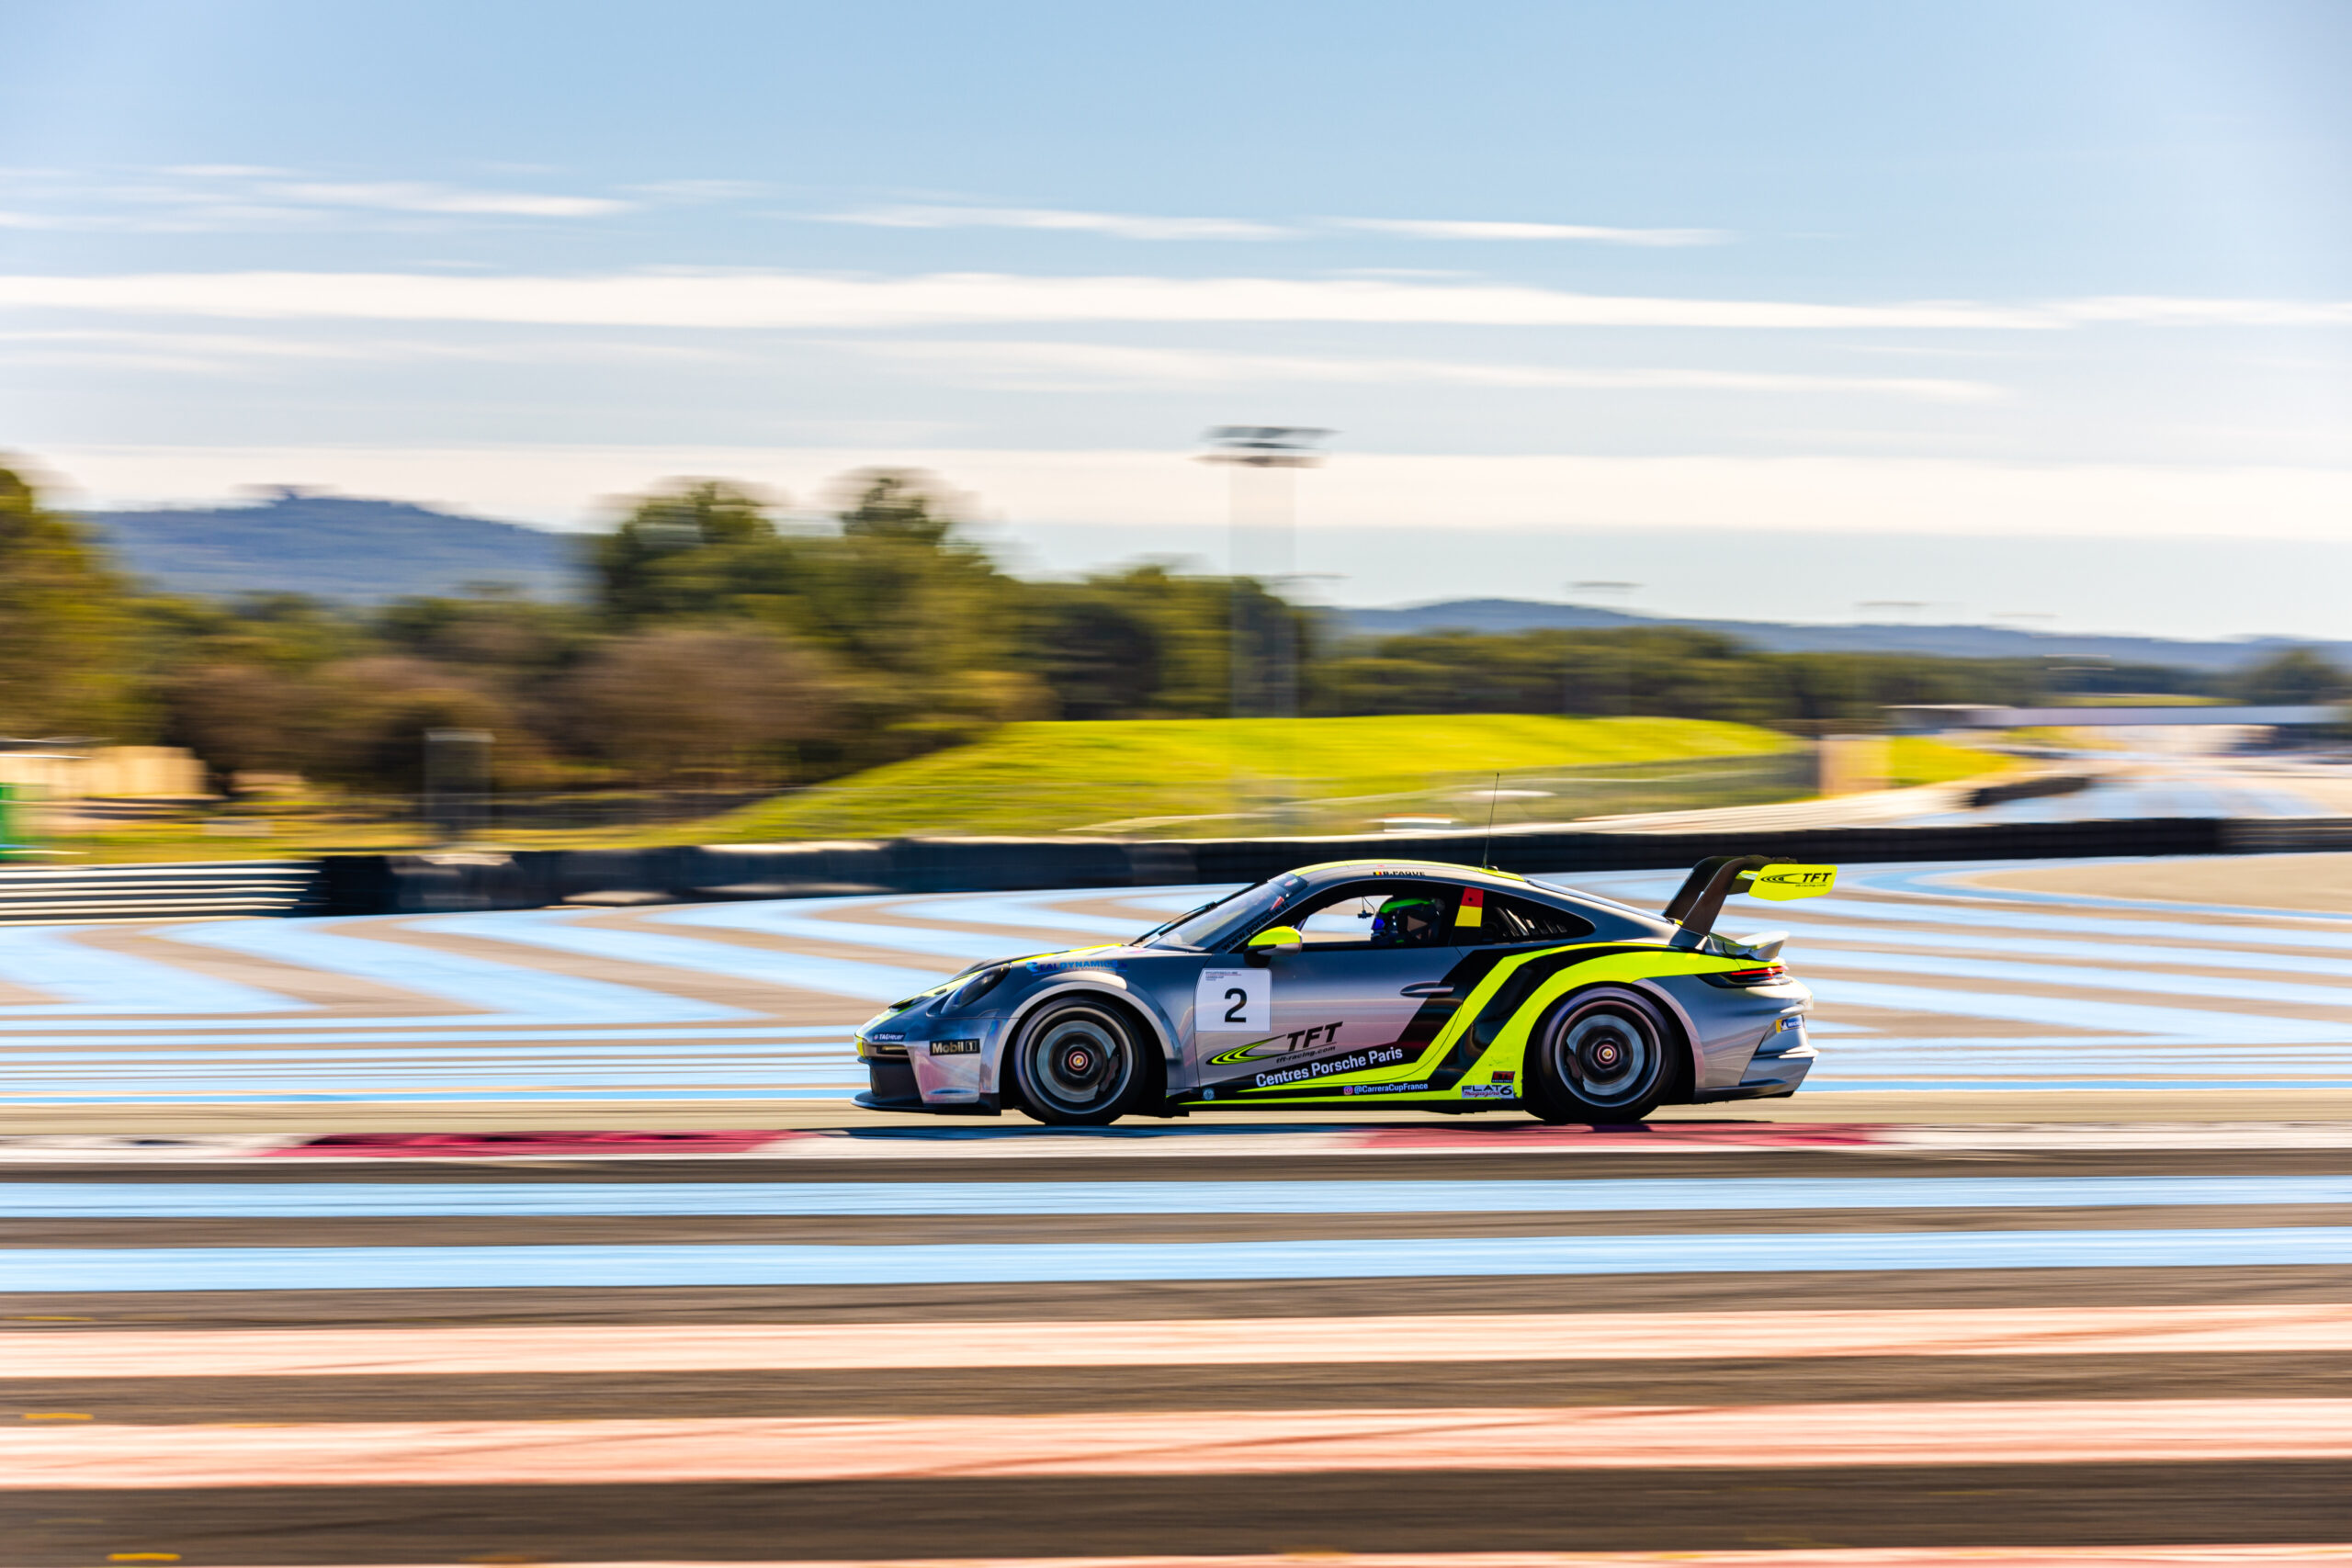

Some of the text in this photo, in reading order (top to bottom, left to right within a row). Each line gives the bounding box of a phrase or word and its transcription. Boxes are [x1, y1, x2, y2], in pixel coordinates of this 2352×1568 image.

[1803, 873, 1832, 883] TFT
[1225, 987, 1247, 1022] 2
[1287, 1021, 1343, 1052] TFT
[932, 1042, 964, 1054] Mobil
[1276, 1045, 1336, 1064] tft-racing.com
[1256, 1046, 1404, 1088] Centres Porsche Paris
[1354, 1082, 1429, 1094] @CarreraCupFrance
[1500, 1085, 1513, 1096] 6
